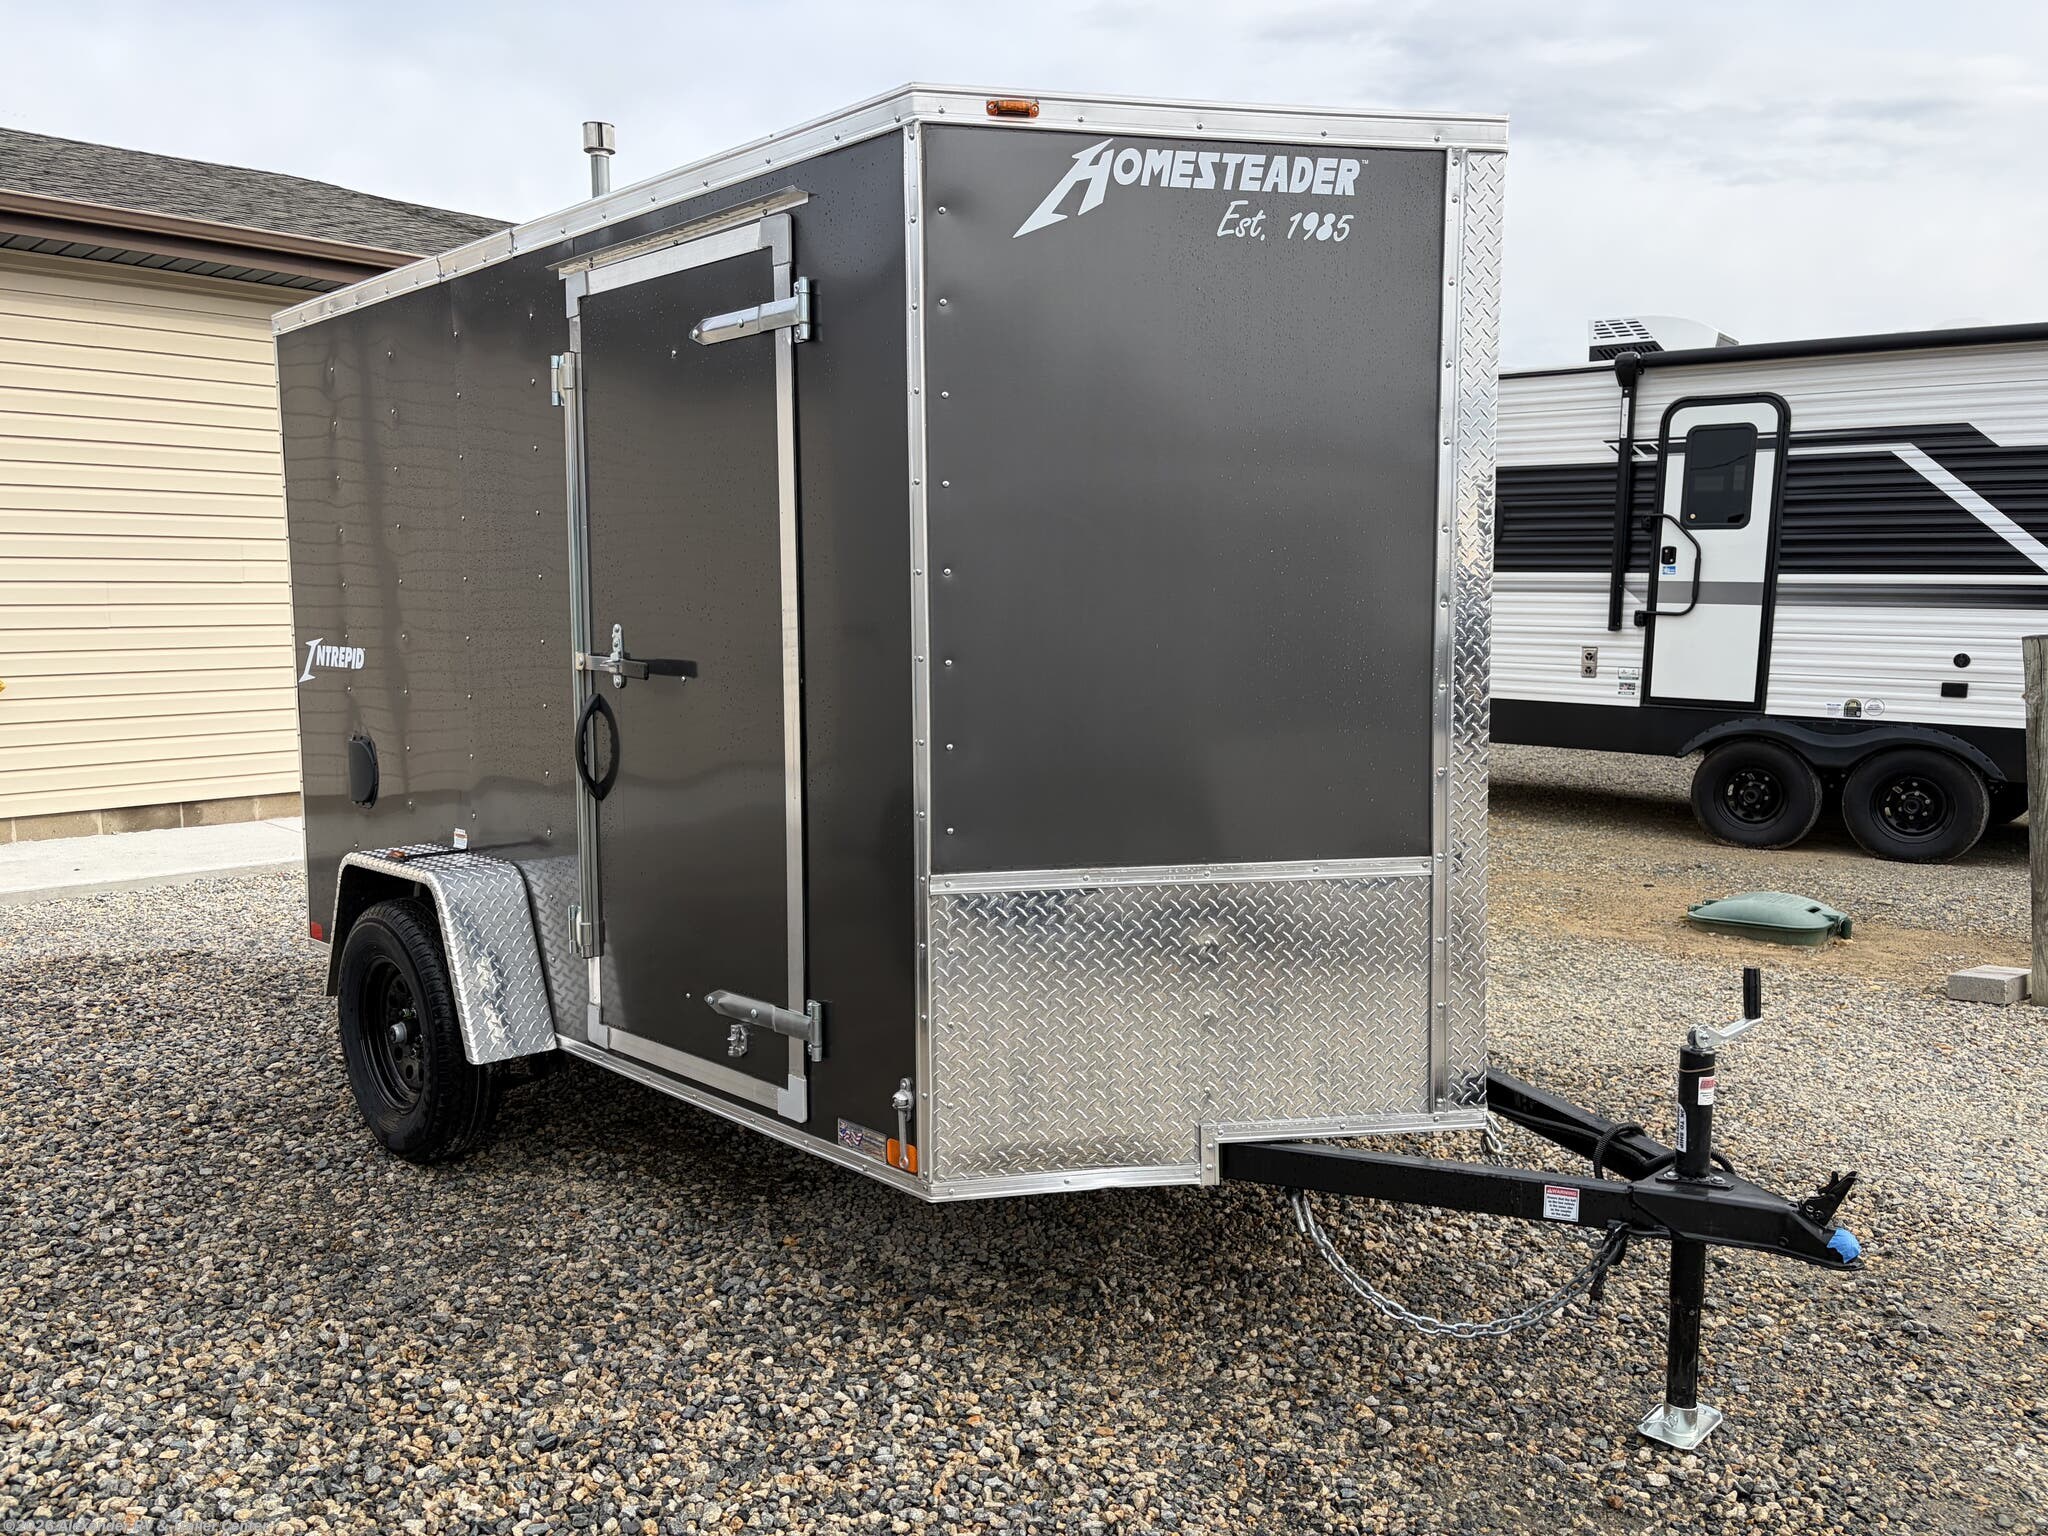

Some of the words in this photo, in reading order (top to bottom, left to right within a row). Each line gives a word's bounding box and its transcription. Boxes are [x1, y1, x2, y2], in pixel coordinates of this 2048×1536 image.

[1013, 138, 1361, 238] HOMESTEADER
[1216, 201, 1267, 241] Est.
[1287, 211, 1354, 242] 1985
[298, 637, 365, 683] INTREPID
